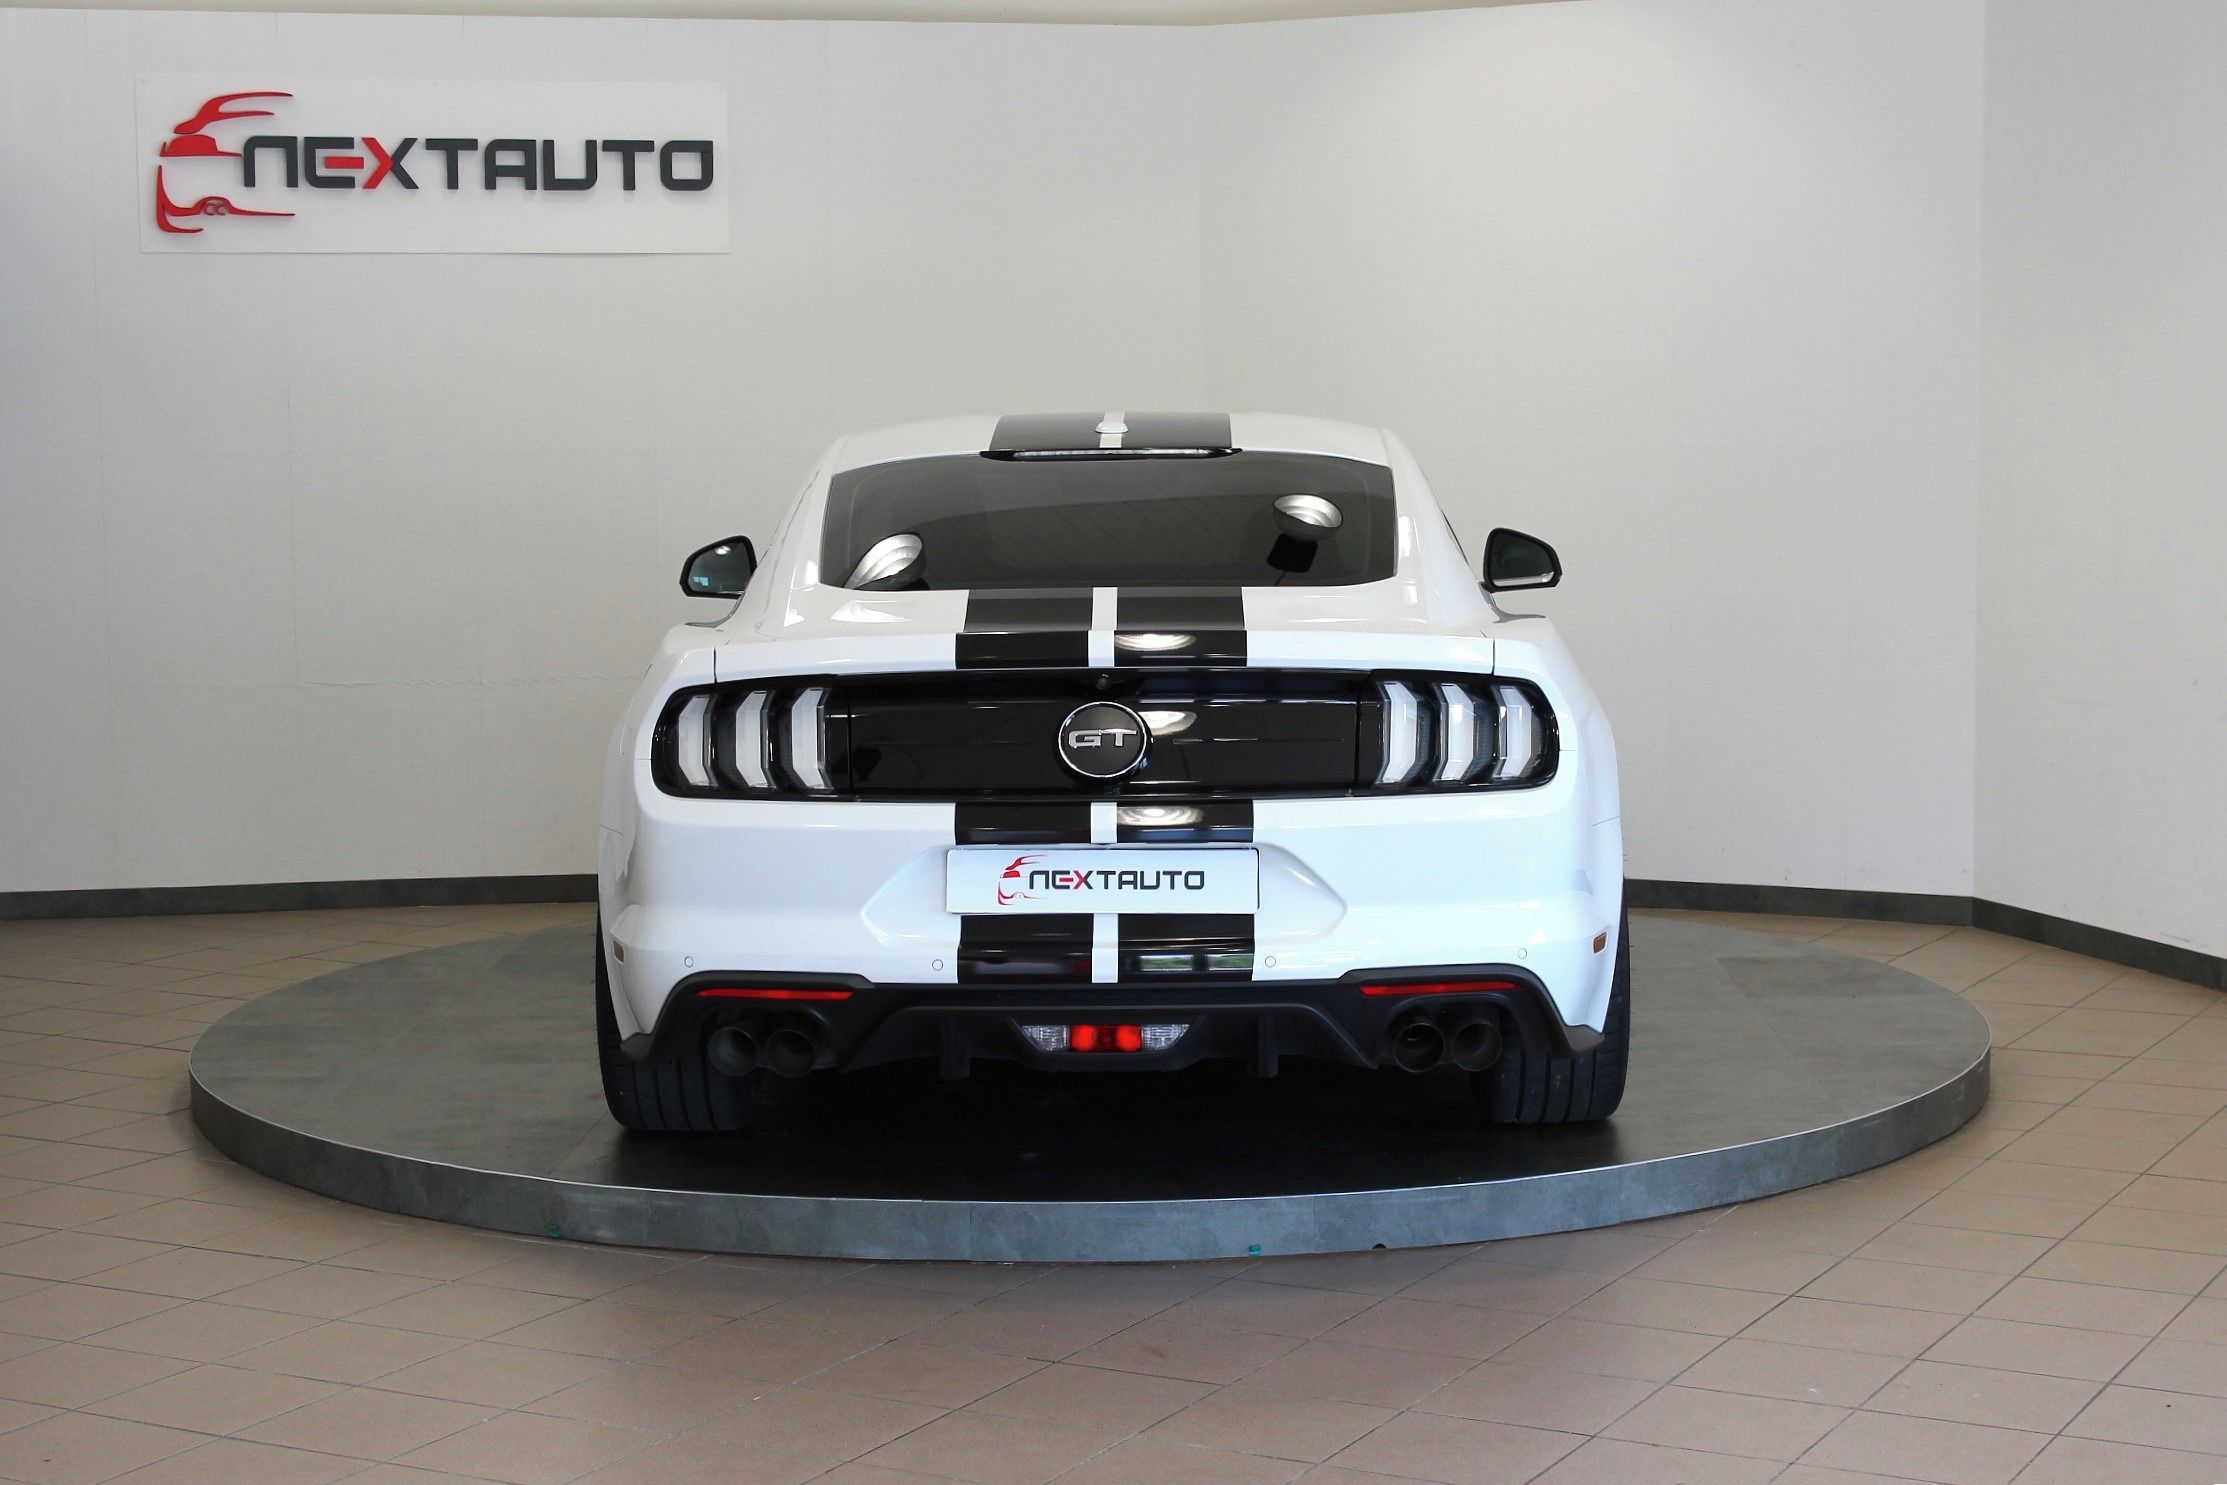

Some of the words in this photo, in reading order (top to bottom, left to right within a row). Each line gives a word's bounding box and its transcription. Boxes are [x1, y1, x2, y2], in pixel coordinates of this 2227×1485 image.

[243, 135, 714, 191] NEXTAUTO
[1069, 729, 1137, 748] GT
[1029, 870, 1205, 890] NEXTAUTO
